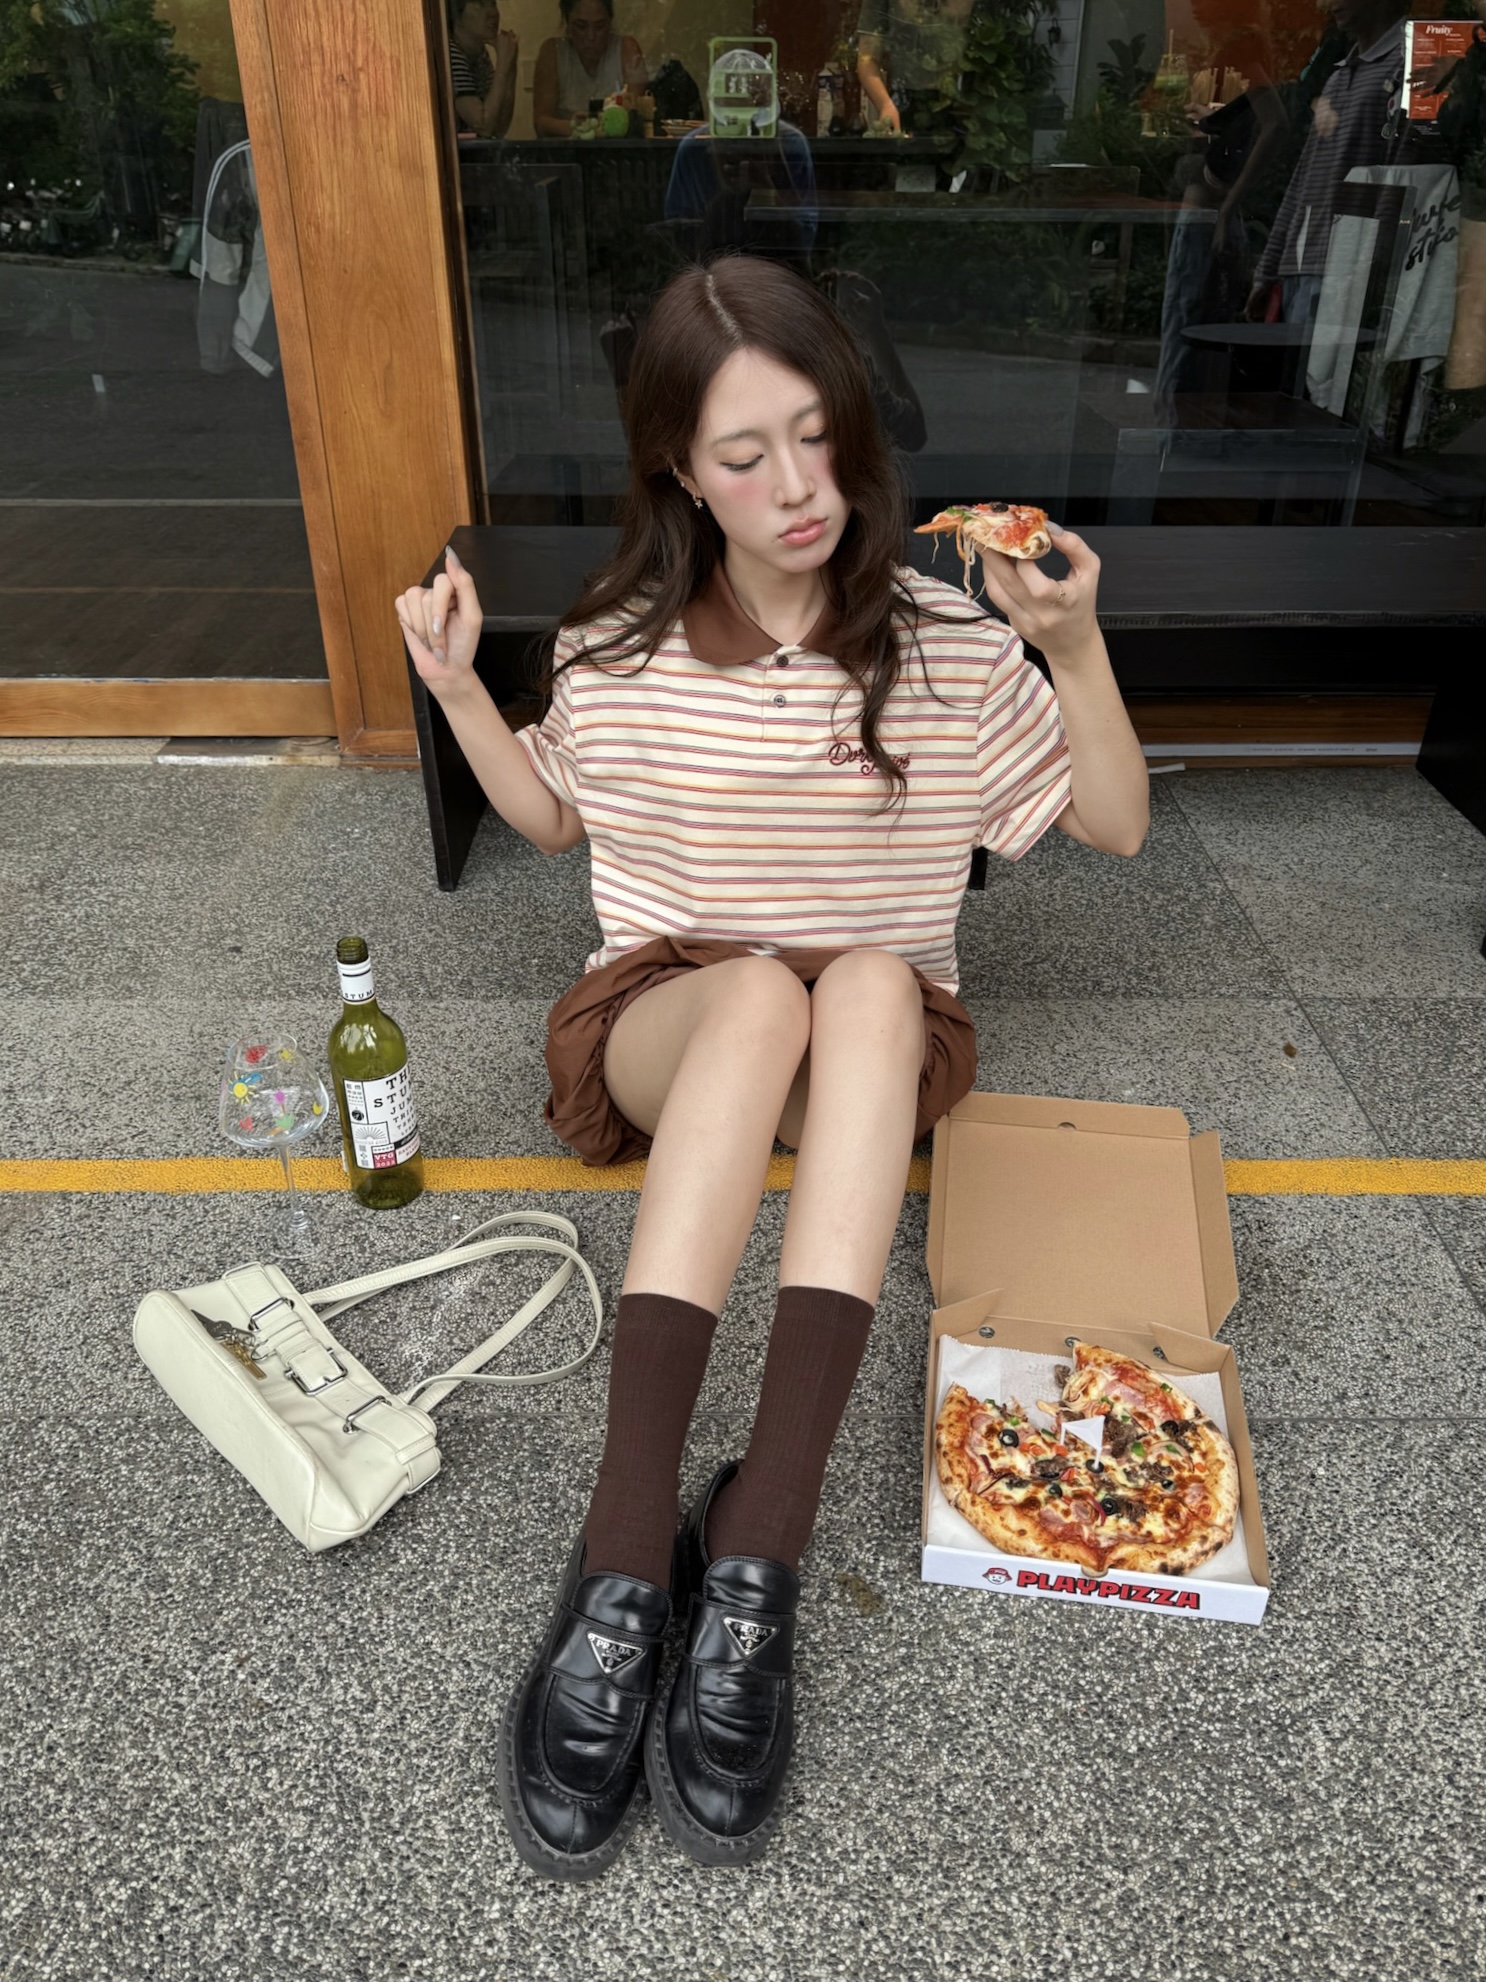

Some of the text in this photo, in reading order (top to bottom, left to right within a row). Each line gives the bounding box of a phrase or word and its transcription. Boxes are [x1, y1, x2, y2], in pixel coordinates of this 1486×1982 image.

[1425, 25, 1453, 36] Fruity
[374, 1152, 394, 1161] VTG
[1016, 1570, 1201, 1610] PLAYPIZZA
[595, 1639, 632, 1657] PRADA
